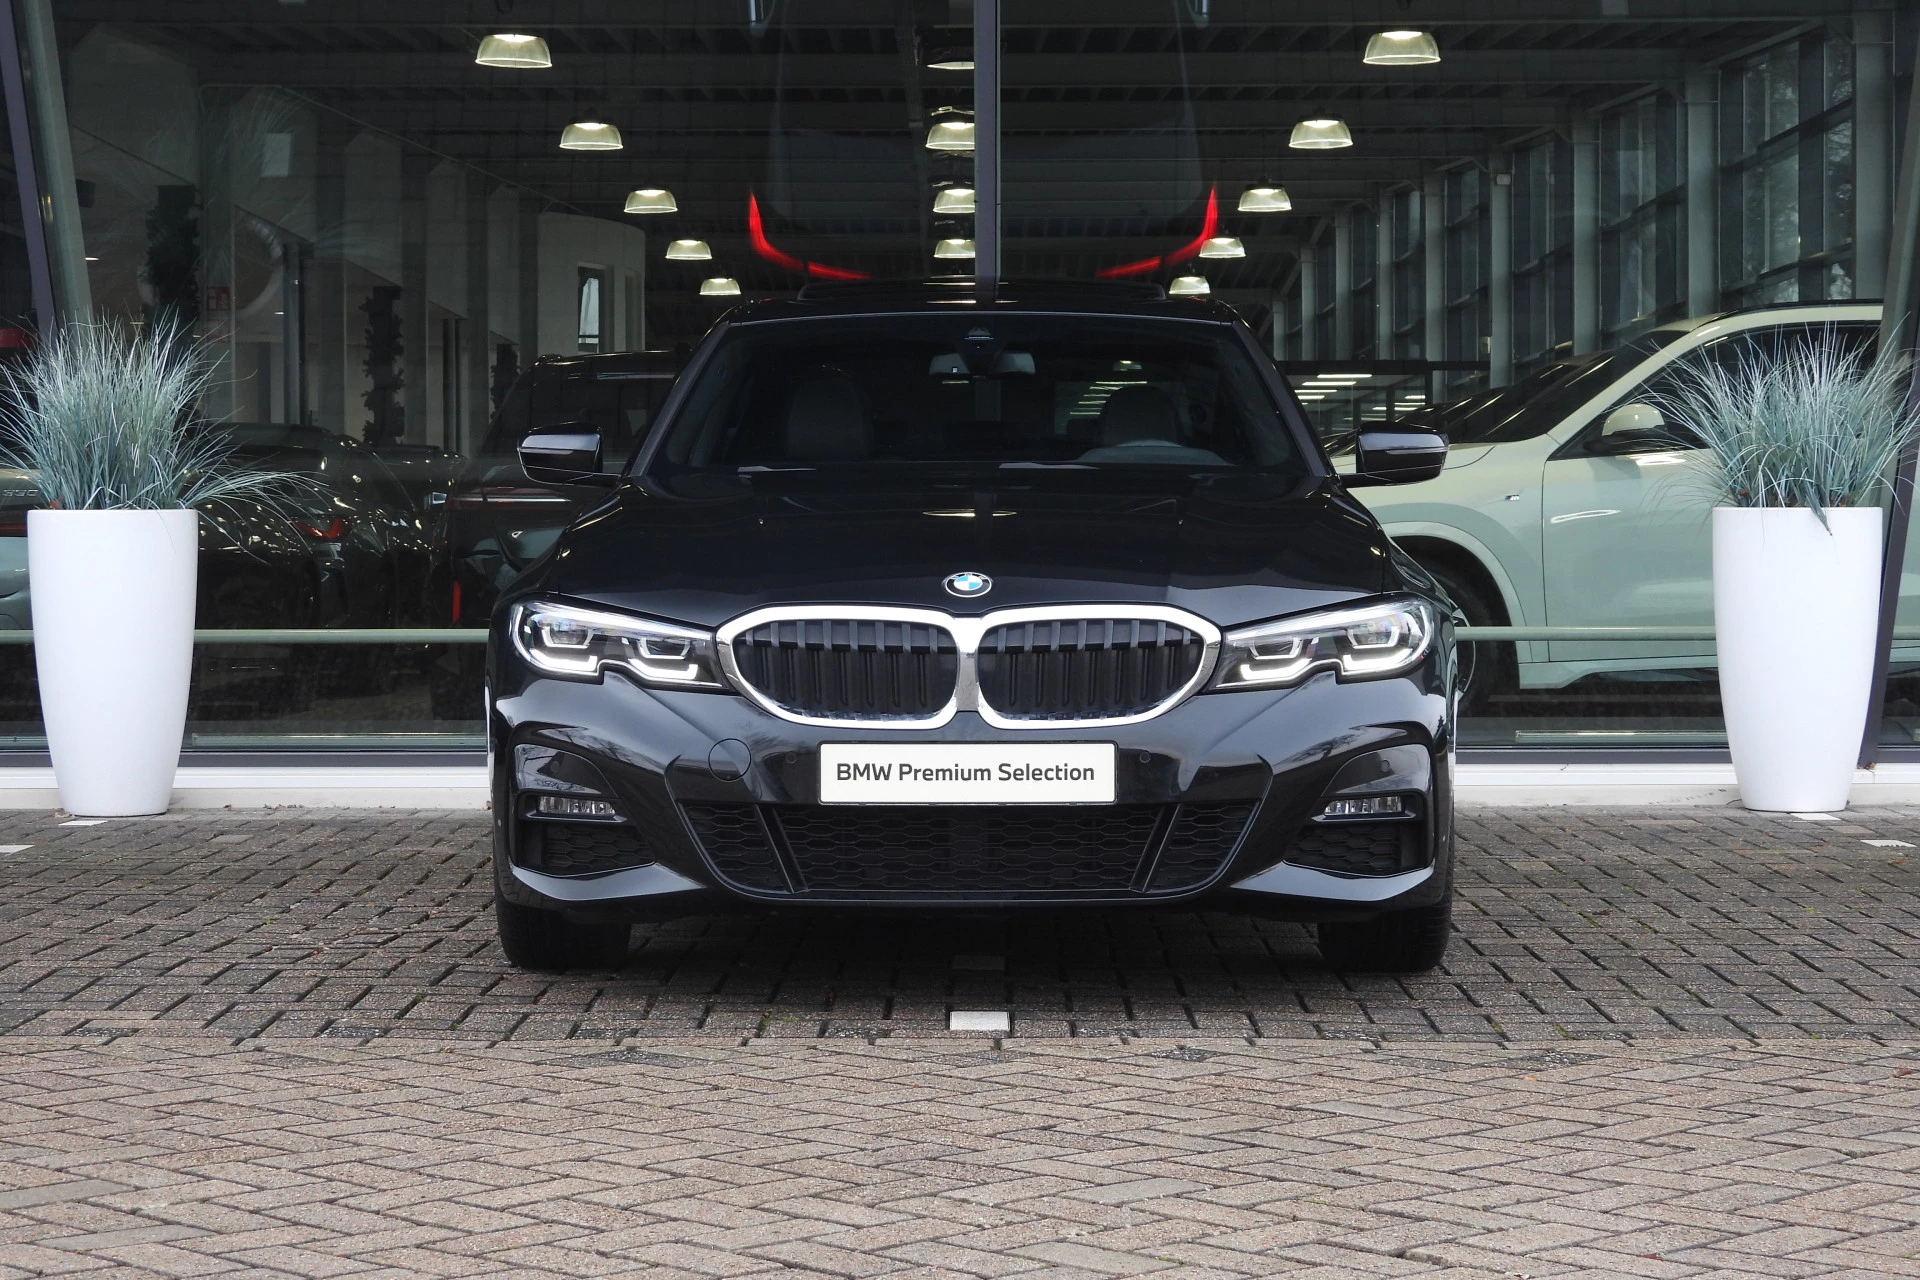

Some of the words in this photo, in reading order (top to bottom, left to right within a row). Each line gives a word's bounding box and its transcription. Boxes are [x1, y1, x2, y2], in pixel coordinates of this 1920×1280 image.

[836, 763, 892, 781] BMW
[899, 763, 991, 781] Premium
[998, 762, 1095, 781] Selection
